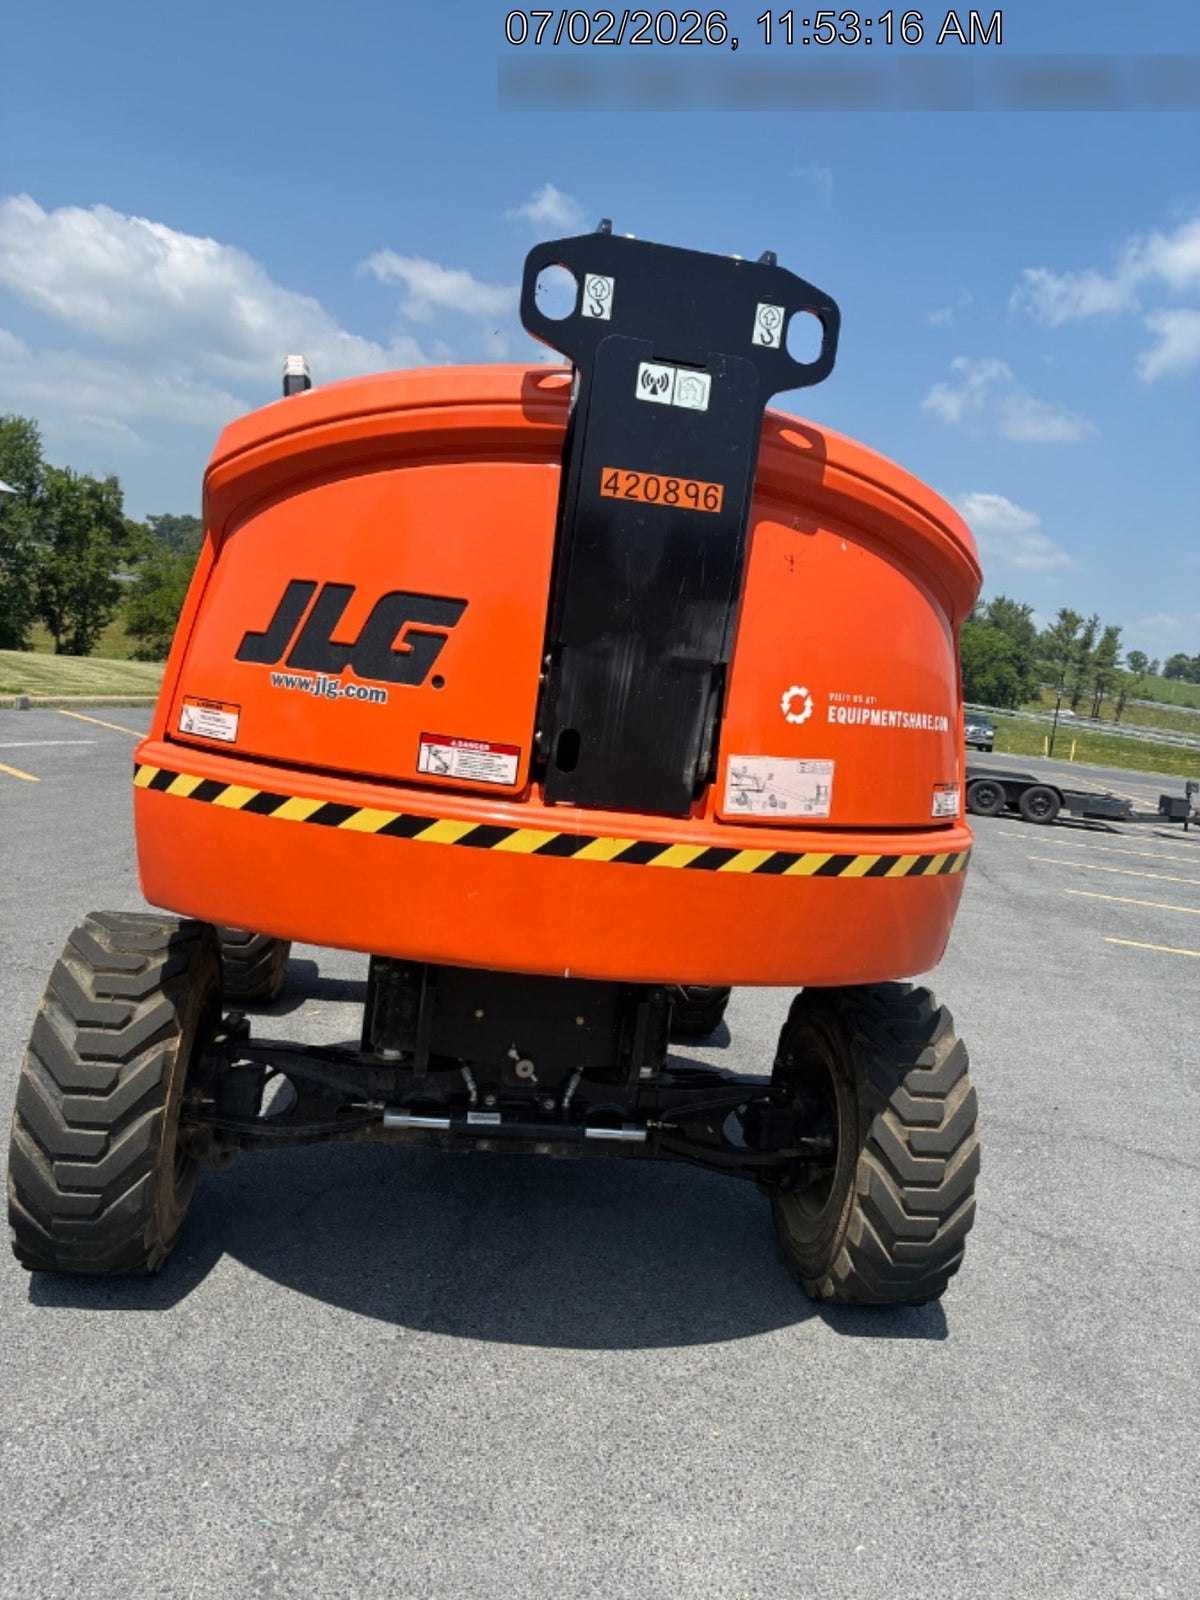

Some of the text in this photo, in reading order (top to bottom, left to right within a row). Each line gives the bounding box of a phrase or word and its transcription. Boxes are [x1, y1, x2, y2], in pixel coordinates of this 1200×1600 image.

[603, 470, 719, 511] 420896
[270, 672, 388, 704] www.jlg.com
[828, 706, 948, 731] EQUIPMENTSHARE.COM
[458, 740, 490, 751] DANGER
